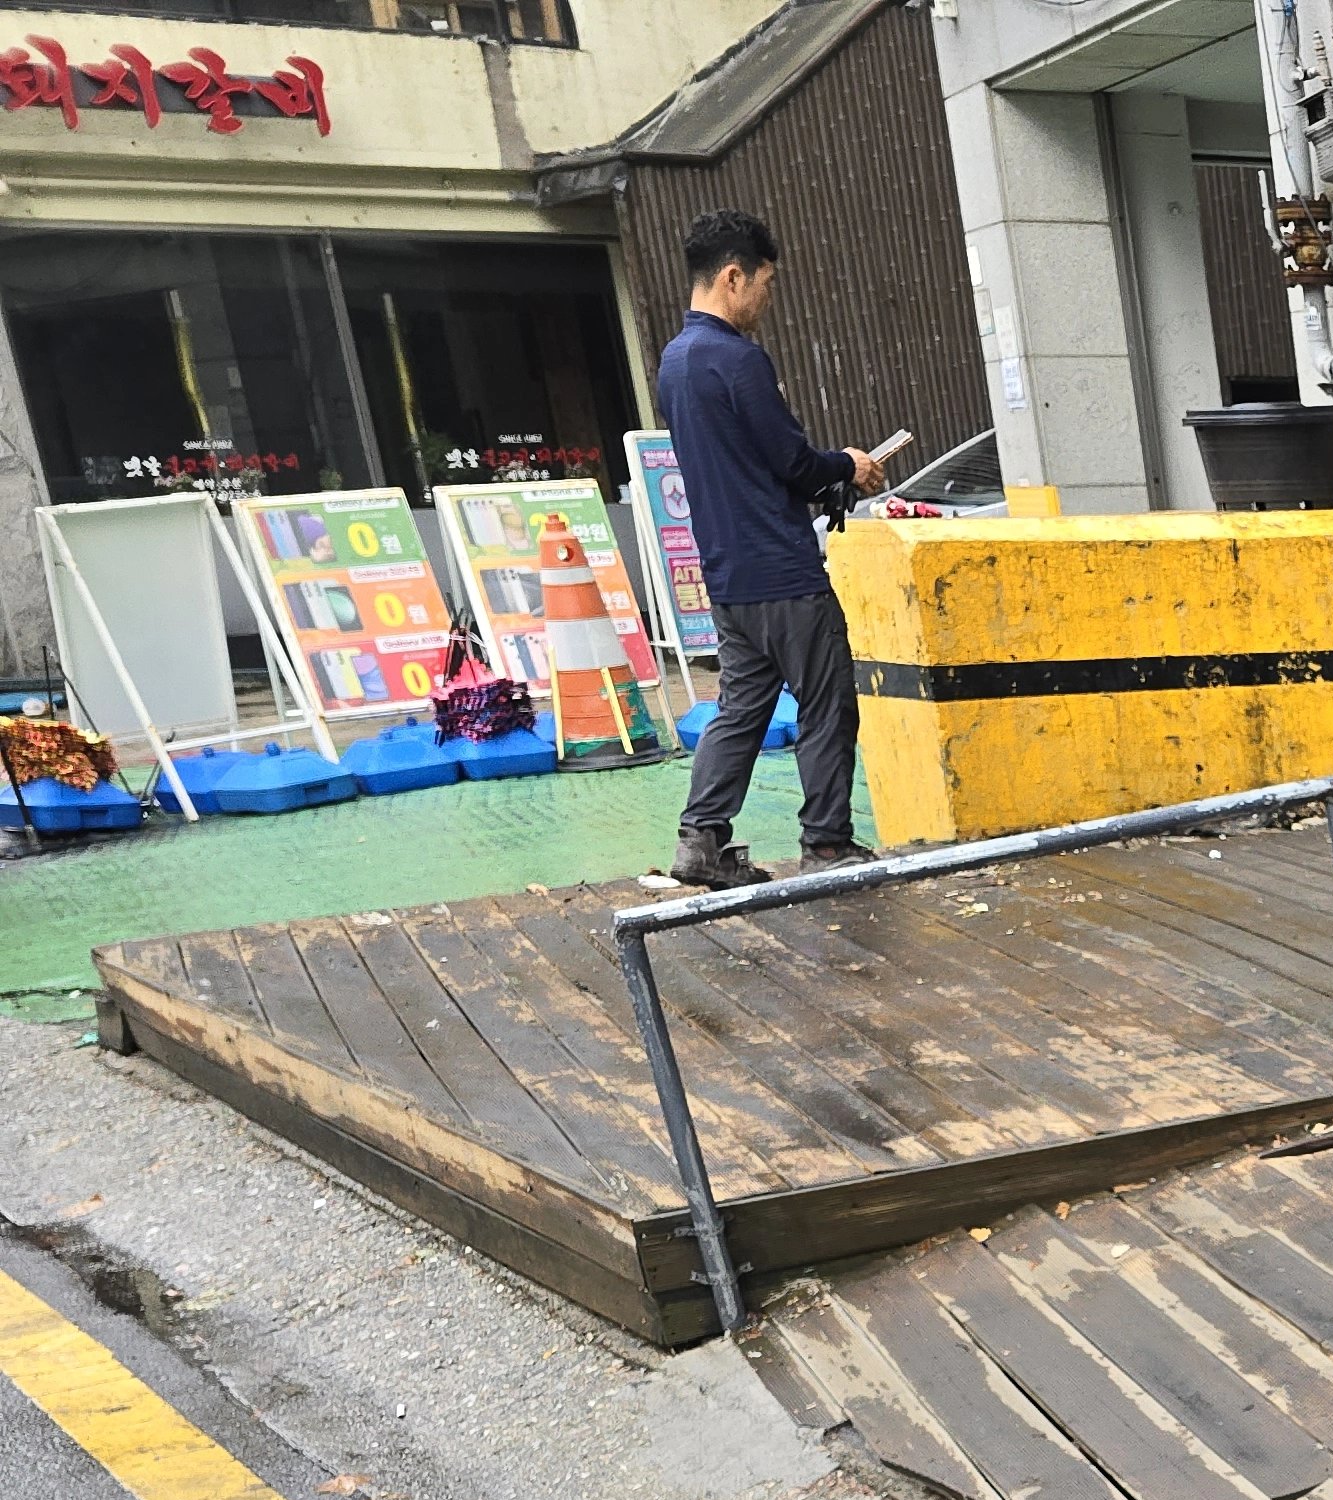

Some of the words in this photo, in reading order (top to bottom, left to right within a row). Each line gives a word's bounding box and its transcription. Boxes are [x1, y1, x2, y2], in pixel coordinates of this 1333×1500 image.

[0, 33, 332, 137] 돼지갈비
[347, 522, 379, 557] 0
[374, 592, 406, 628] 0
[402, 661, 432, 697] 0
